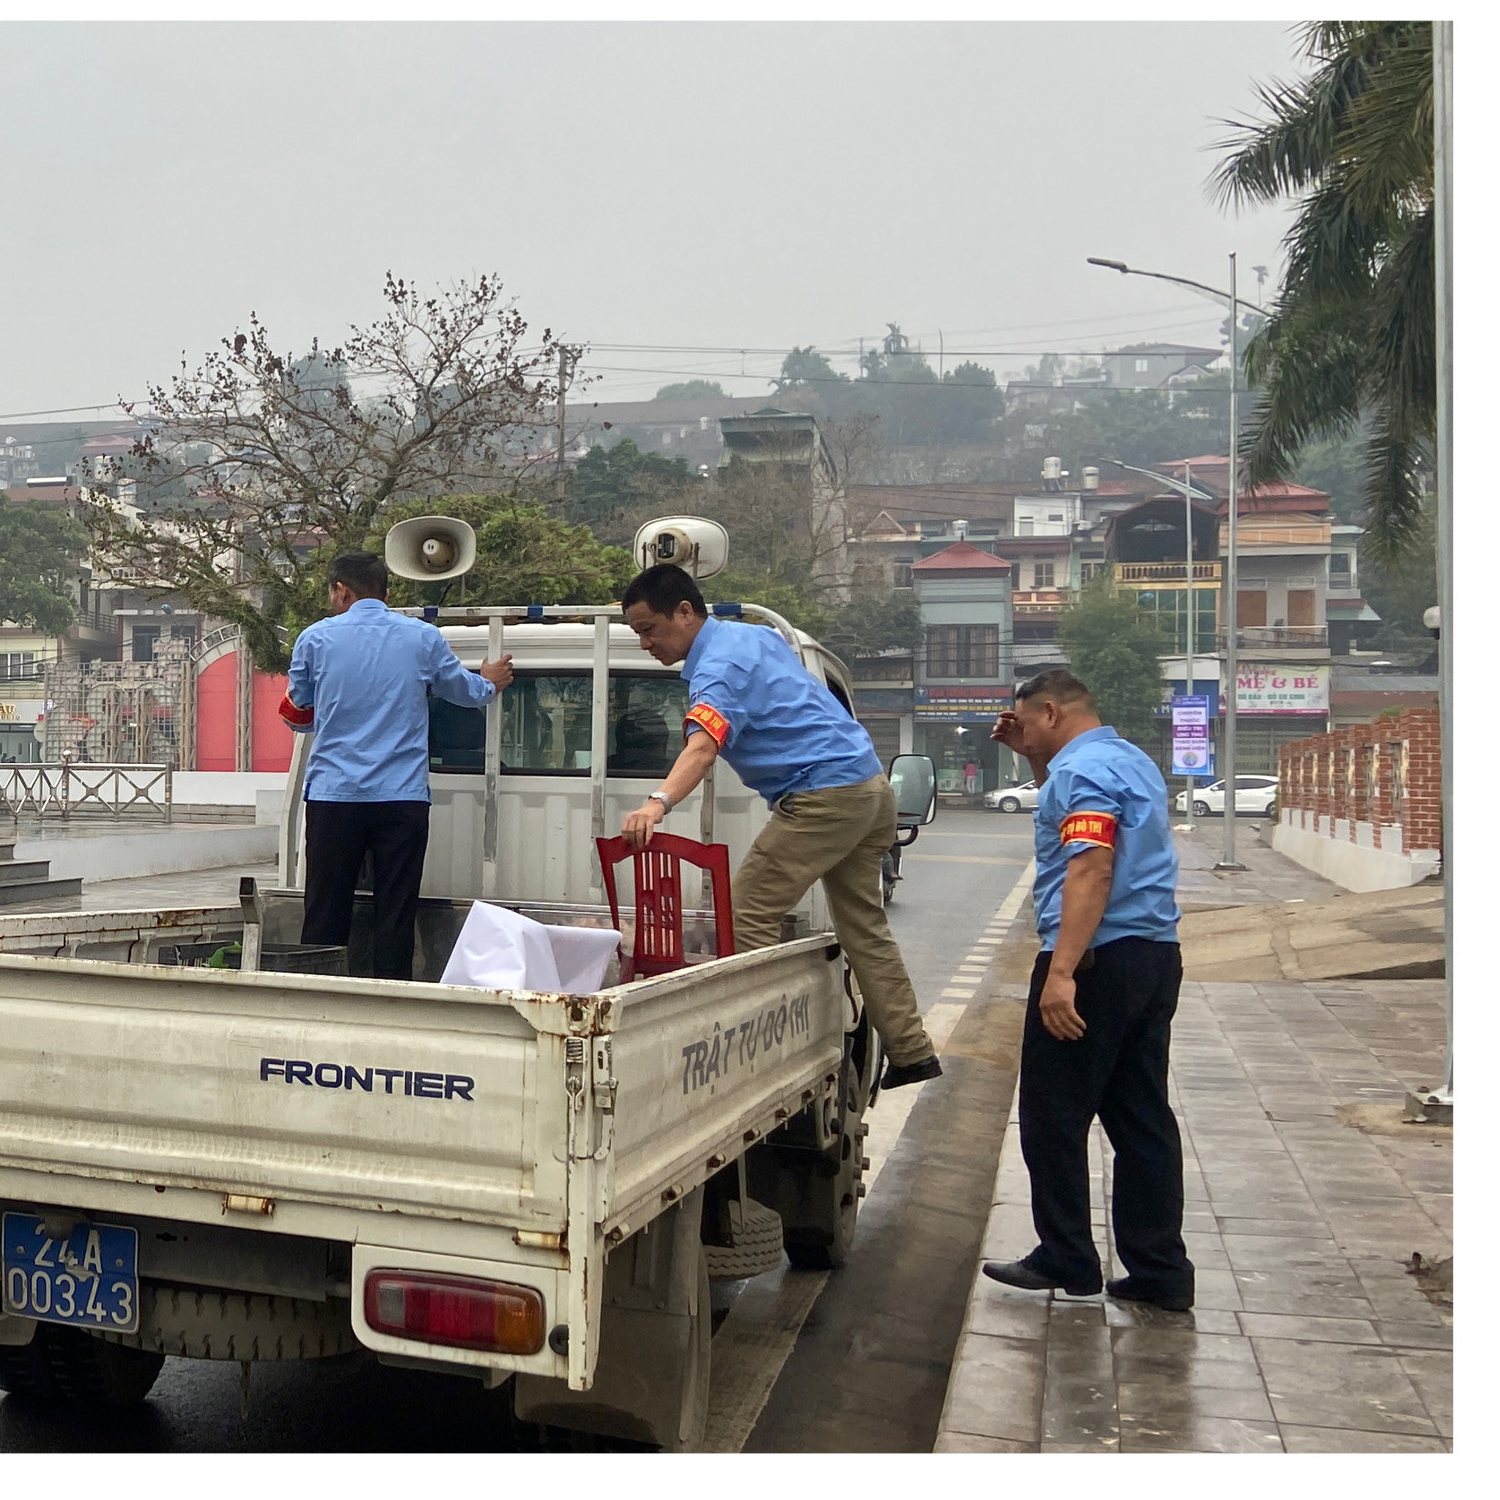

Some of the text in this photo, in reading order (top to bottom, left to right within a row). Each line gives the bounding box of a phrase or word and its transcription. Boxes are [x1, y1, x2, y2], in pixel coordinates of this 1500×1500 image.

[1271, 677, 1287, 689] &
[682, 1021, 736, 1096] TRẬT
[739, 1009, 764, 1074] TỰ
[790, 993, 810, 1041] THỊ
[258, 1056, 476, 1101] FRONTIER
[7, 1267, 133, 1326] 003.43
